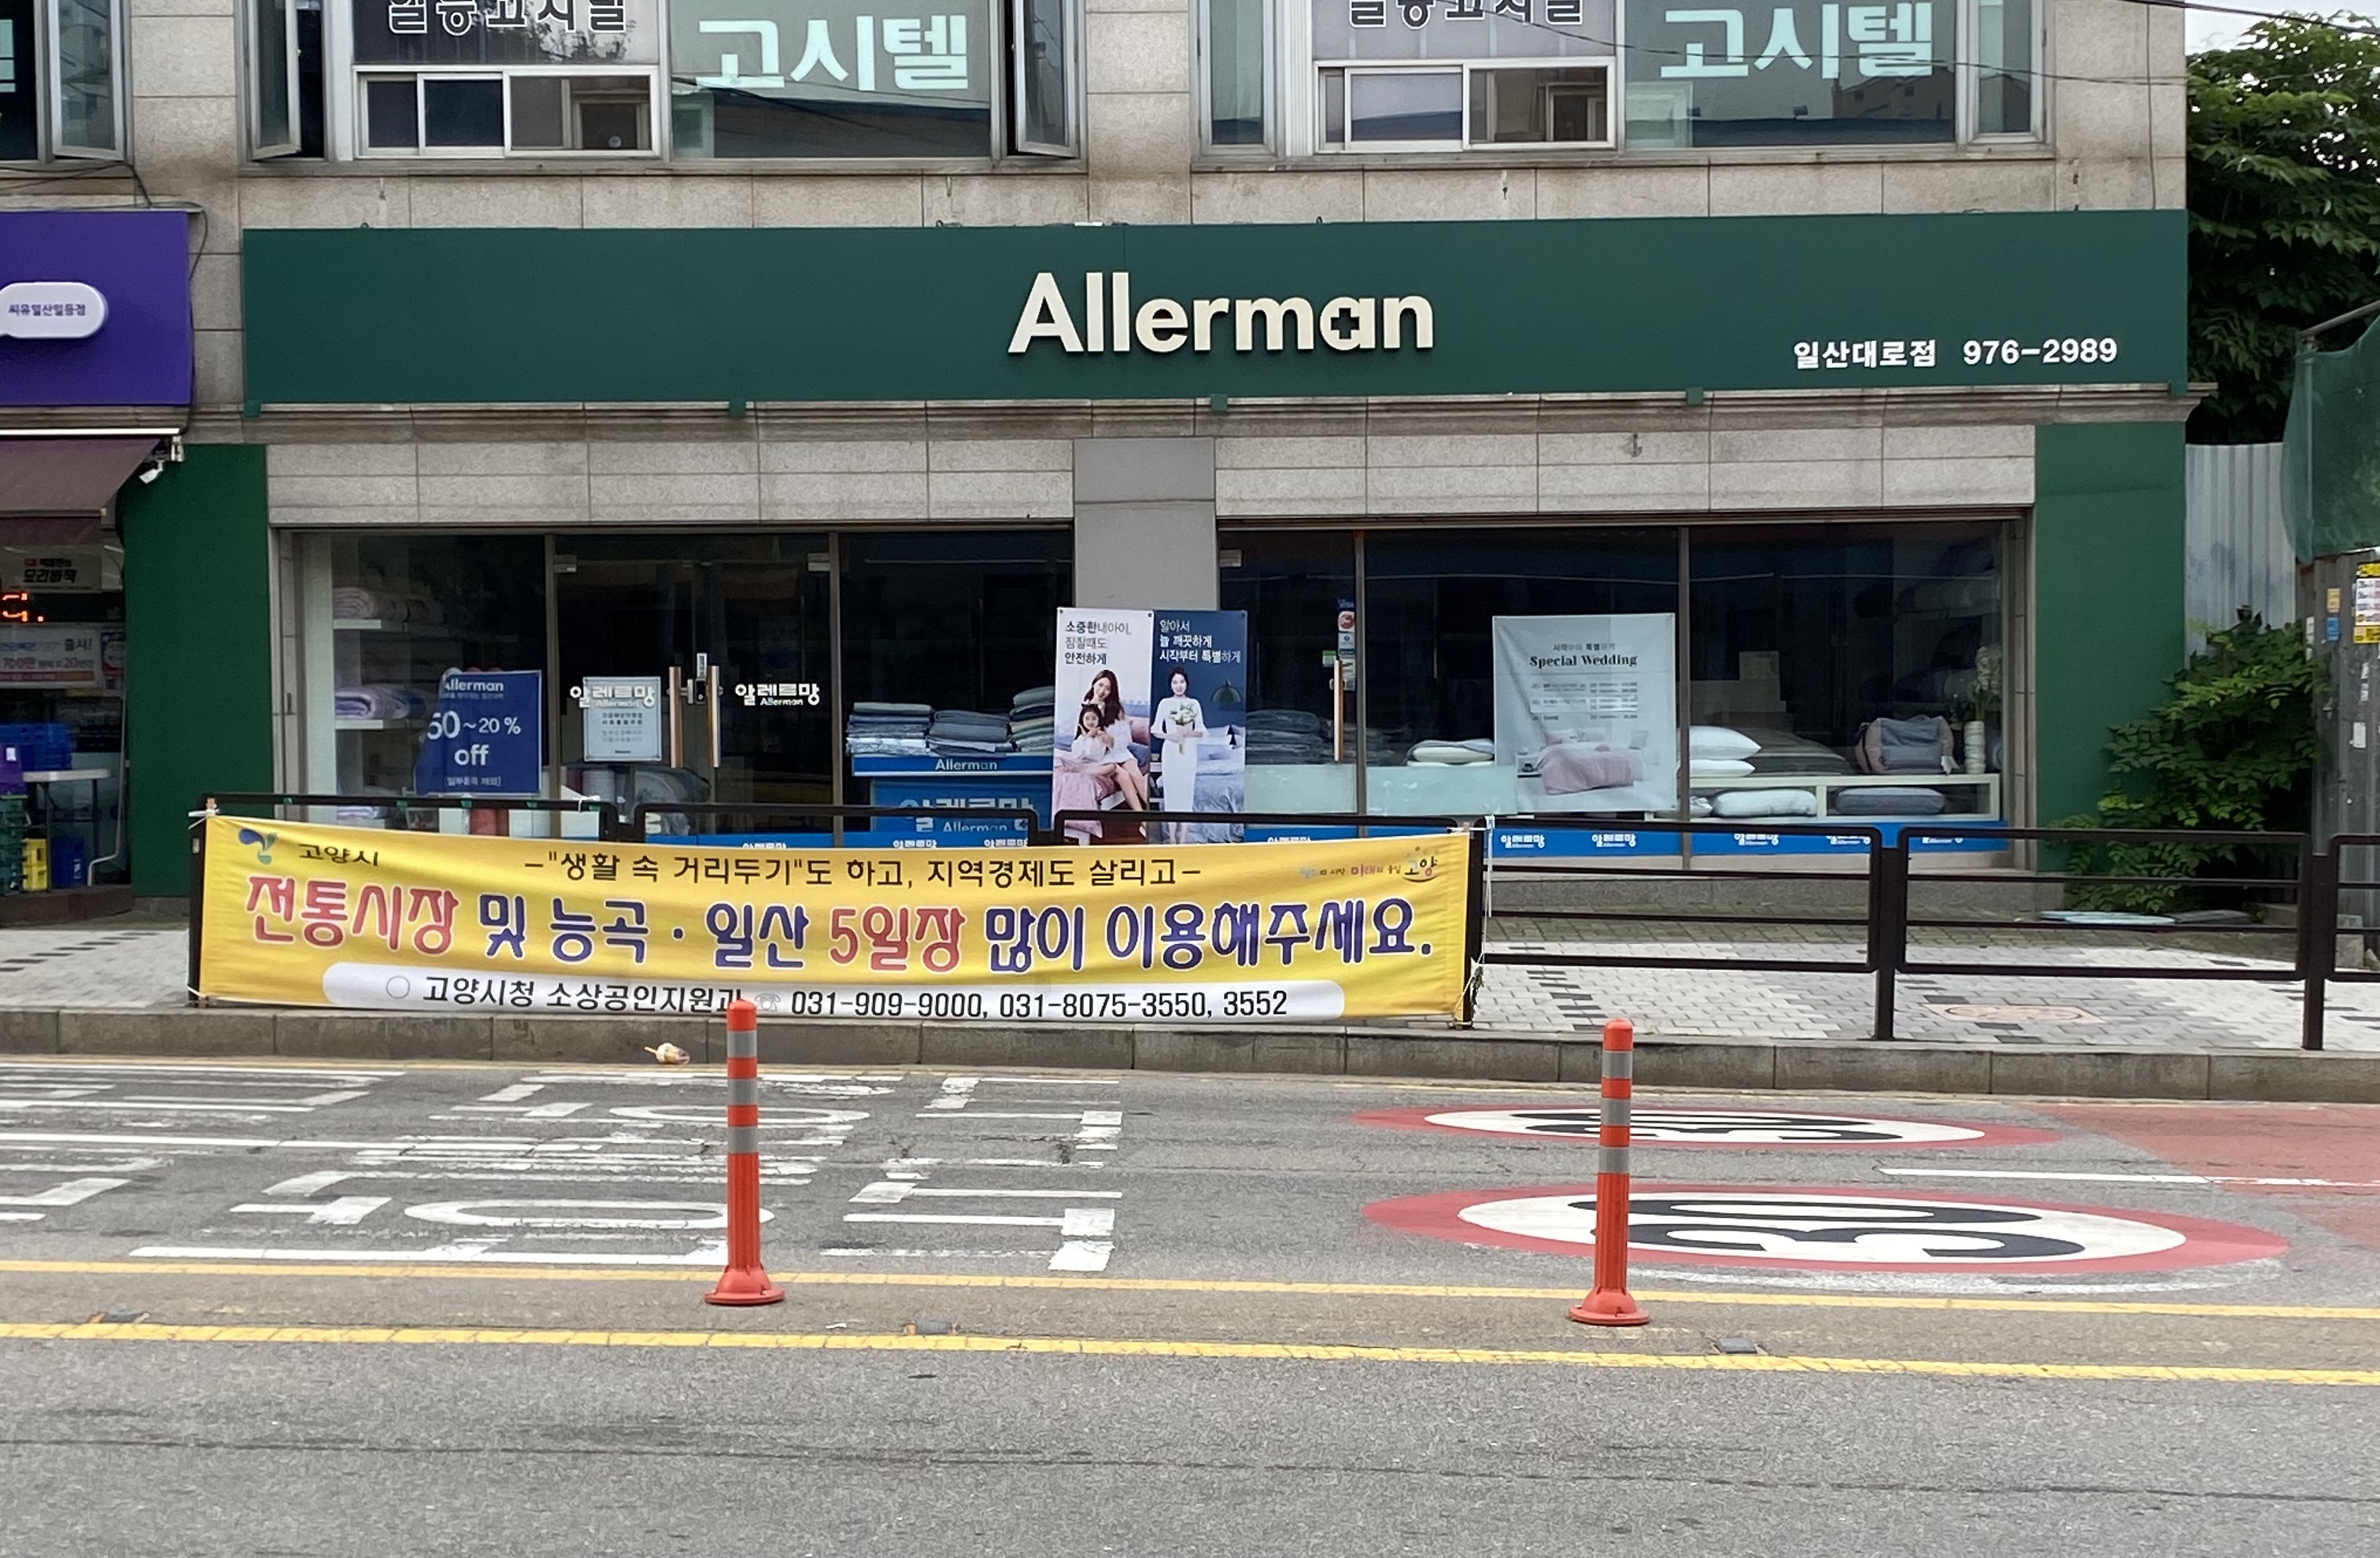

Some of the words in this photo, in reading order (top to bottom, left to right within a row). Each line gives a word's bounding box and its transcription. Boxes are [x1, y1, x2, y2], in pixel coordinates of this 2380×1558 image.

[1661, 2, 1932, 79] 고시텔
[696, 15, 968, 91] 고시텔
[1007, 271, 1433, 353] Allerman
[1794, 339, 1936, 369] 일산대로점
[1963, 338, 2118, 365] 976-2989
[1064, 652, 1107, 665] 안전하게
[1159, 649, 1198, 663] 시작부터
[1529, 655, 1577, 669] Special
[1581, 654, 1639, 668] Wedding
[570, 686, 656, 708] 알레르망
[735, 683, 819, 706] 알레르망
[454, 744, 490, 766] off
[935, 758, 998, 772] Allerman
[298, 843, 379, 866] 고양시
[632, 854, 659, 883] 속
[846, 859, 913, 889] 하고,
[927, 858, 1074, 889] 지역경제도
[246, 875, 460, 955] 전통시장
[479, 894, 525, 959] 및
[550, 896, 650, 965] 능곡
[705, 901, 811, 970] 일산
[830, 905, 966, 974] 5일장
[985, 905, 1085, 974] 많이
[1105, 897, 1432, 972] 이용해주세요.
[423, 976, 534, 1008] 고양시청
[791, 991, 989, 1020] 031-909-9000,
[999, 991, 1214, 1020] 031-8075-3550,
[1222, 990, 1288, 1016] 3552
